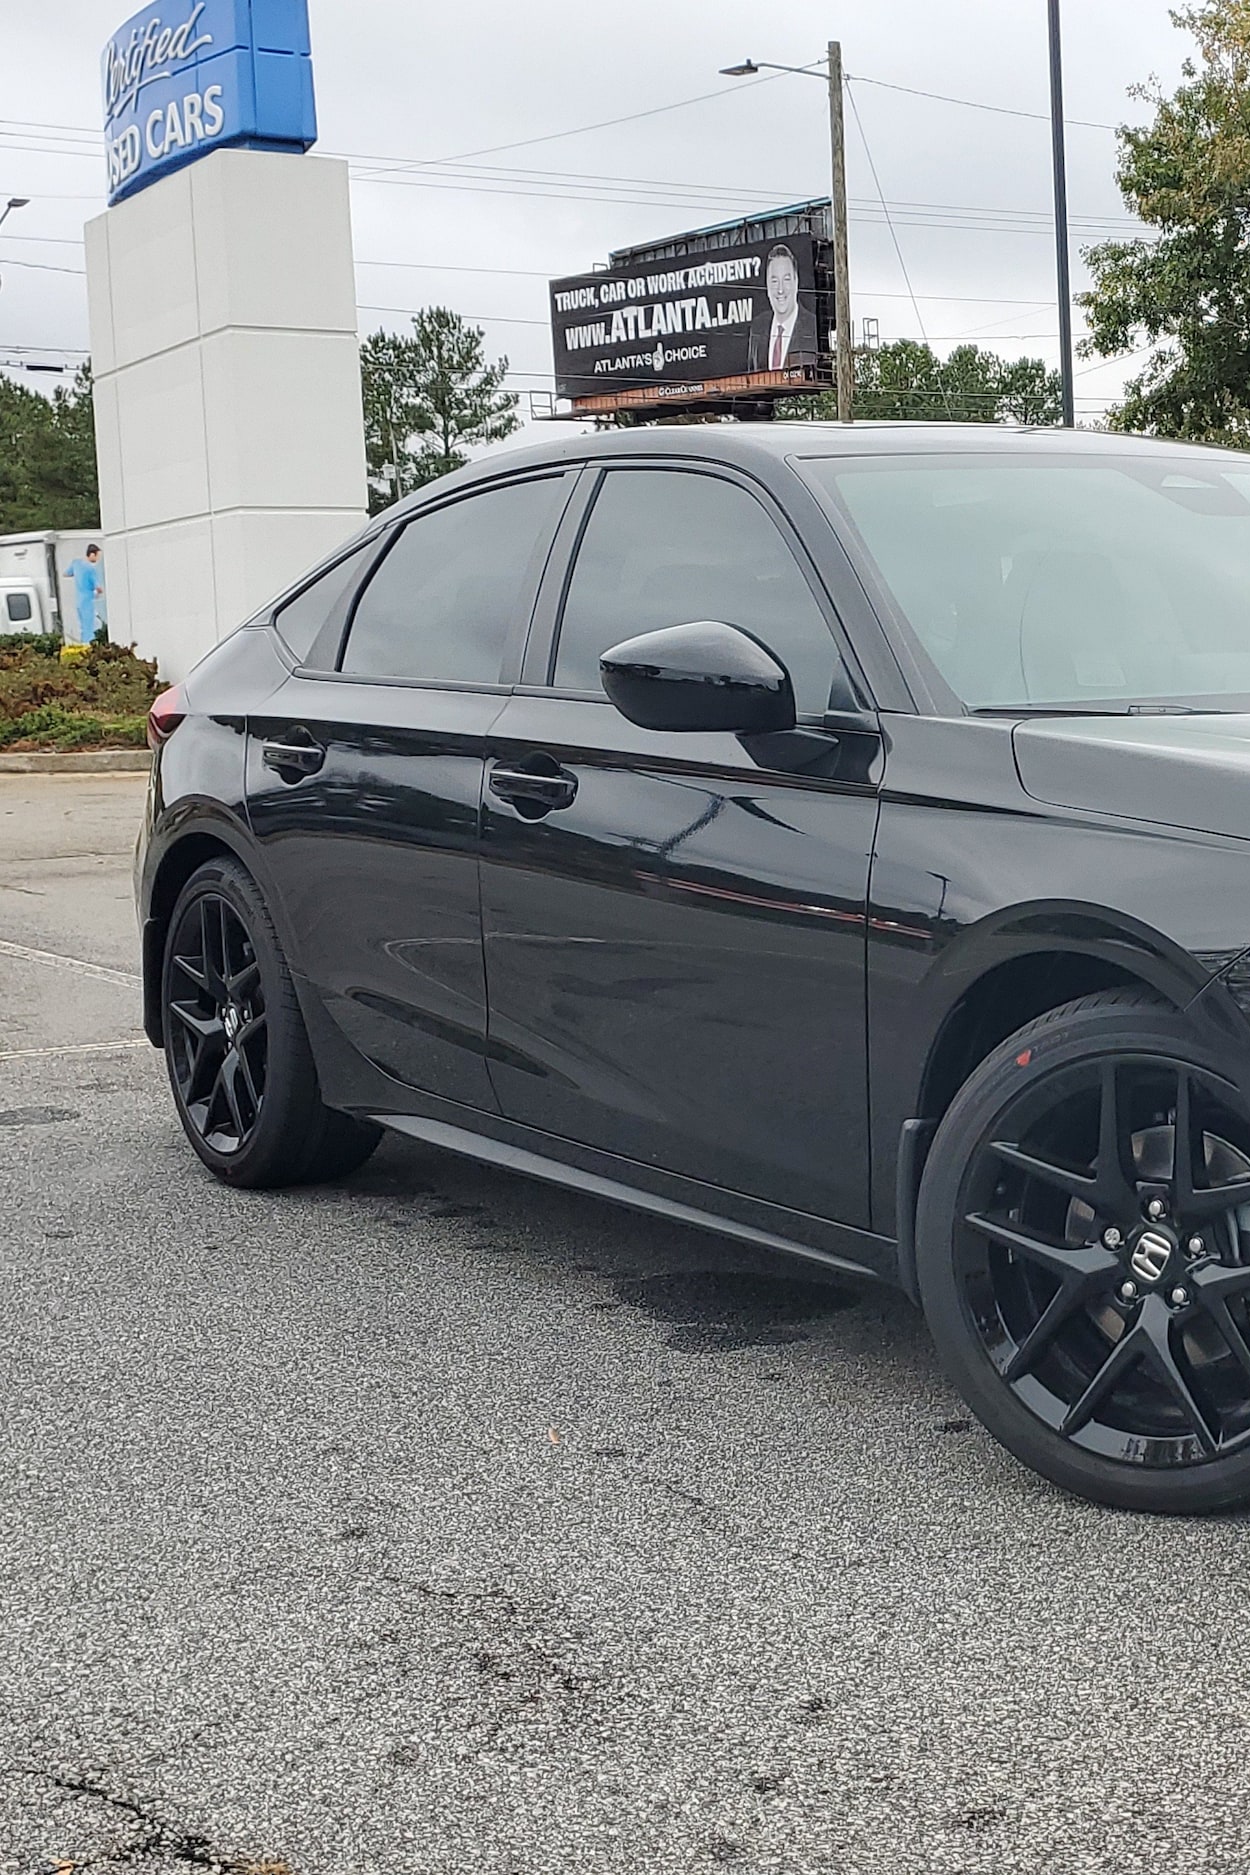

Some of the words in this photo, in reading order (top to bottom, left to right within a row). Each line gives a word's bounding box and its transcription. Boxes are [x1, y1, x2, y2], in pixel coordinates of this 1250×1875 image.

[104, 2, 213, 116] Certified
[145, 85, 224, 159] CARS
[554, 286, 599, 312] TRUCK,
[600, 281, 626, 304] CAR
[627, 277, 646, 299] OR
[646, 270, 686, 295] WORK
[688, 256, 762, 289] ACCIDENT?
[593, 352, 652, 374] ATLANTA'S
[664, 345, 707, 363] CHOICE
